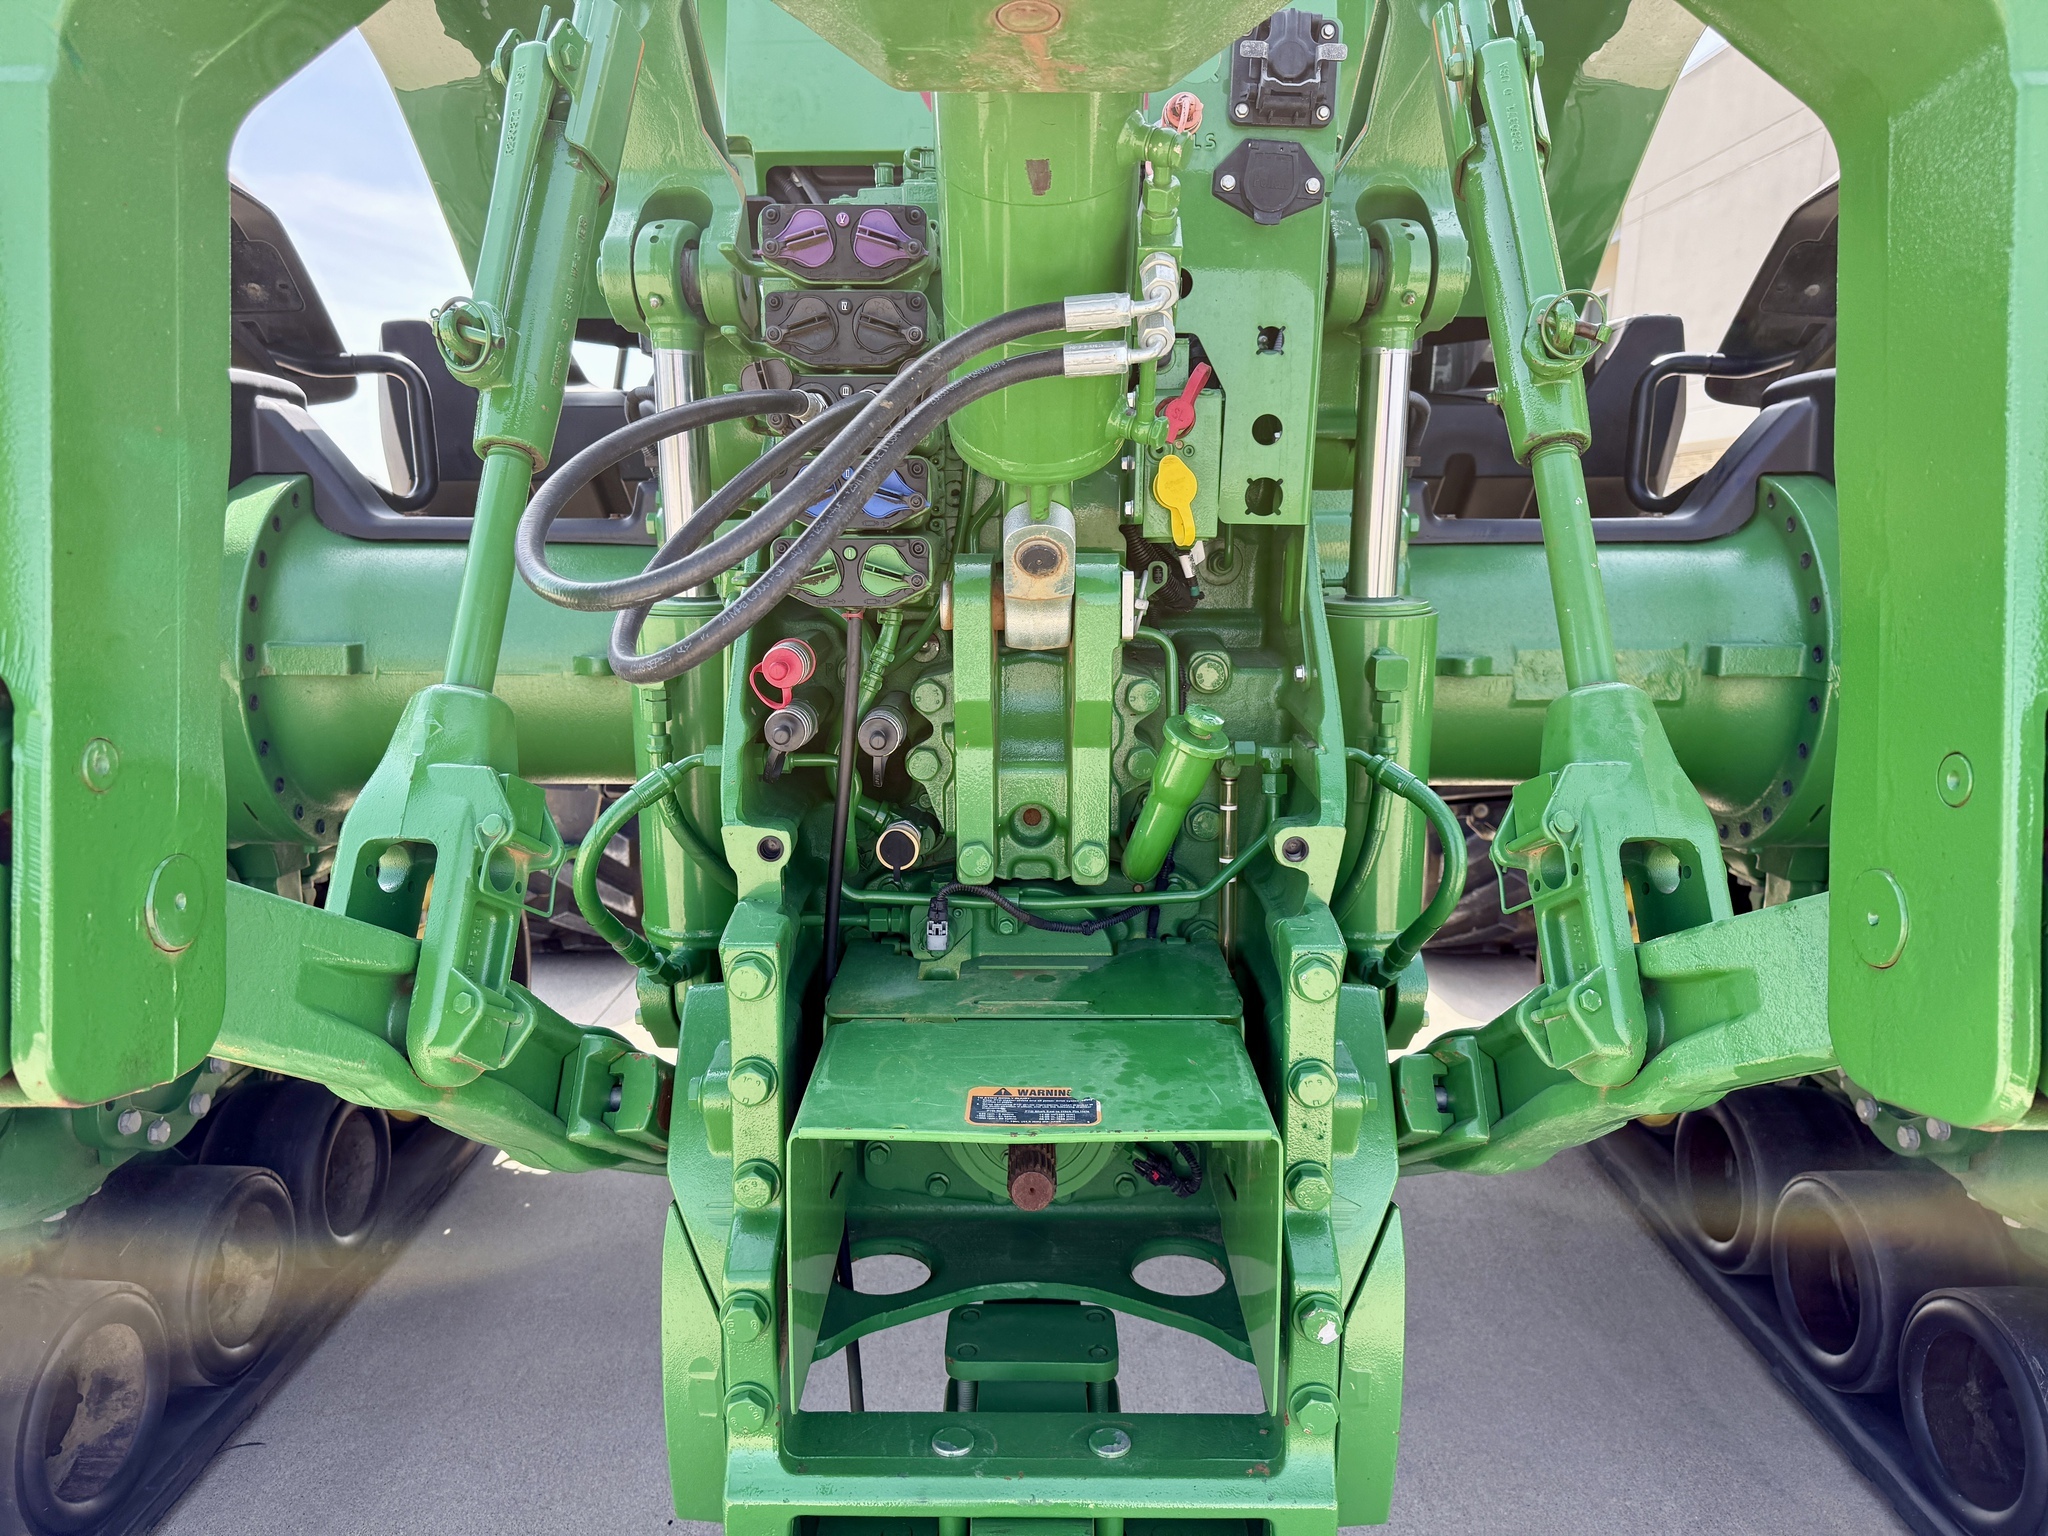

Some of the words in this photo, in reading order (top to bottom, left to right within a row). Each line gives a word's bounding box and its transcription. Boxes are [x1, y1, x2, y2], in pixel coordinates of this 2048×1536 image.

[1498, 60, 1511, 83] USA
[727, 599, 749, 618] MPa
[744, 579, 771, 602] (3000
[863, 448, 885, 472] MADE
